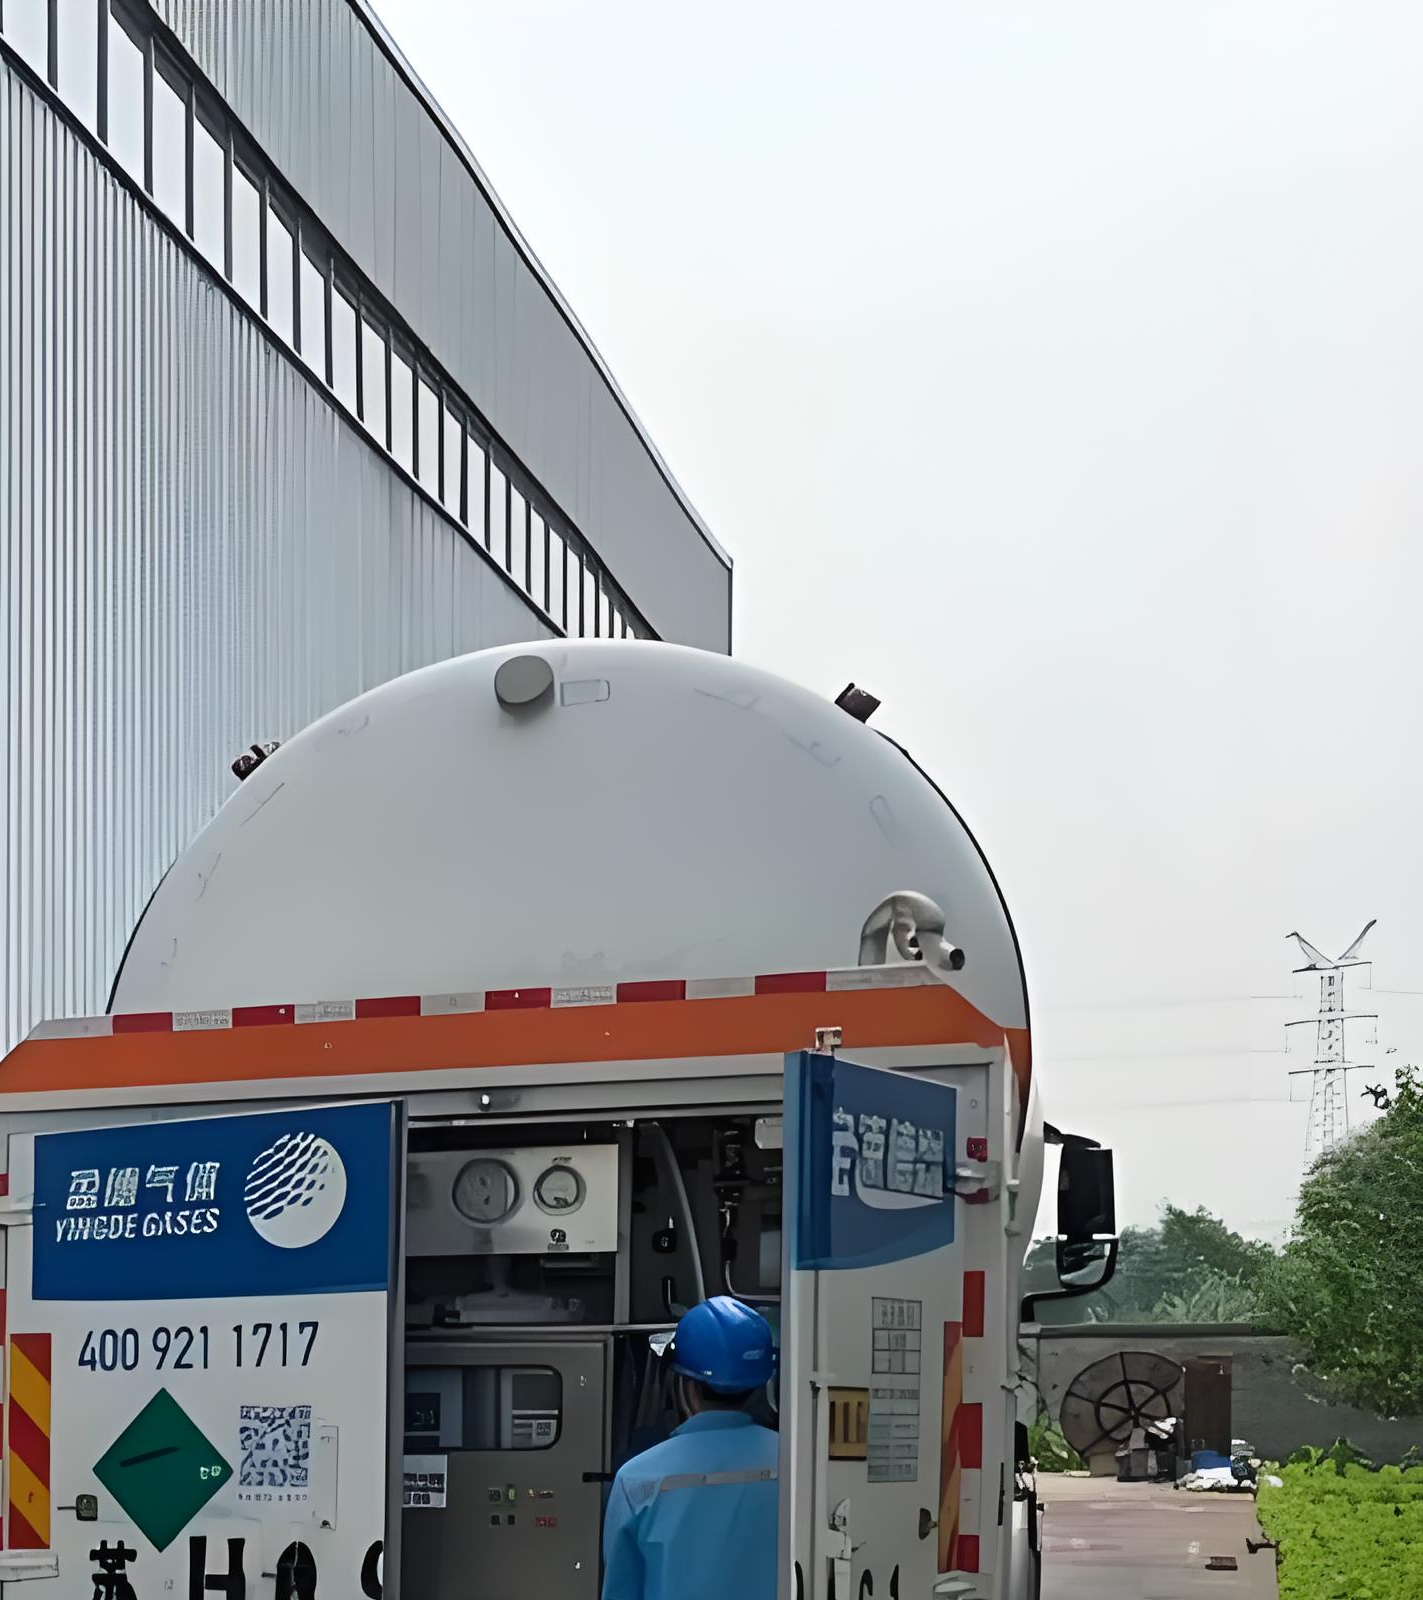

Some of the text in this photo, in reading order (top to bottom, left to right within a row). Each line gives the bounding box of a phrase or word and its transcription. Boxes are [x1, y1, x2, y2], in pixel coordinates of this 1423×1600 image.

[78, 1321, 319, 1372] 400 921 1717
